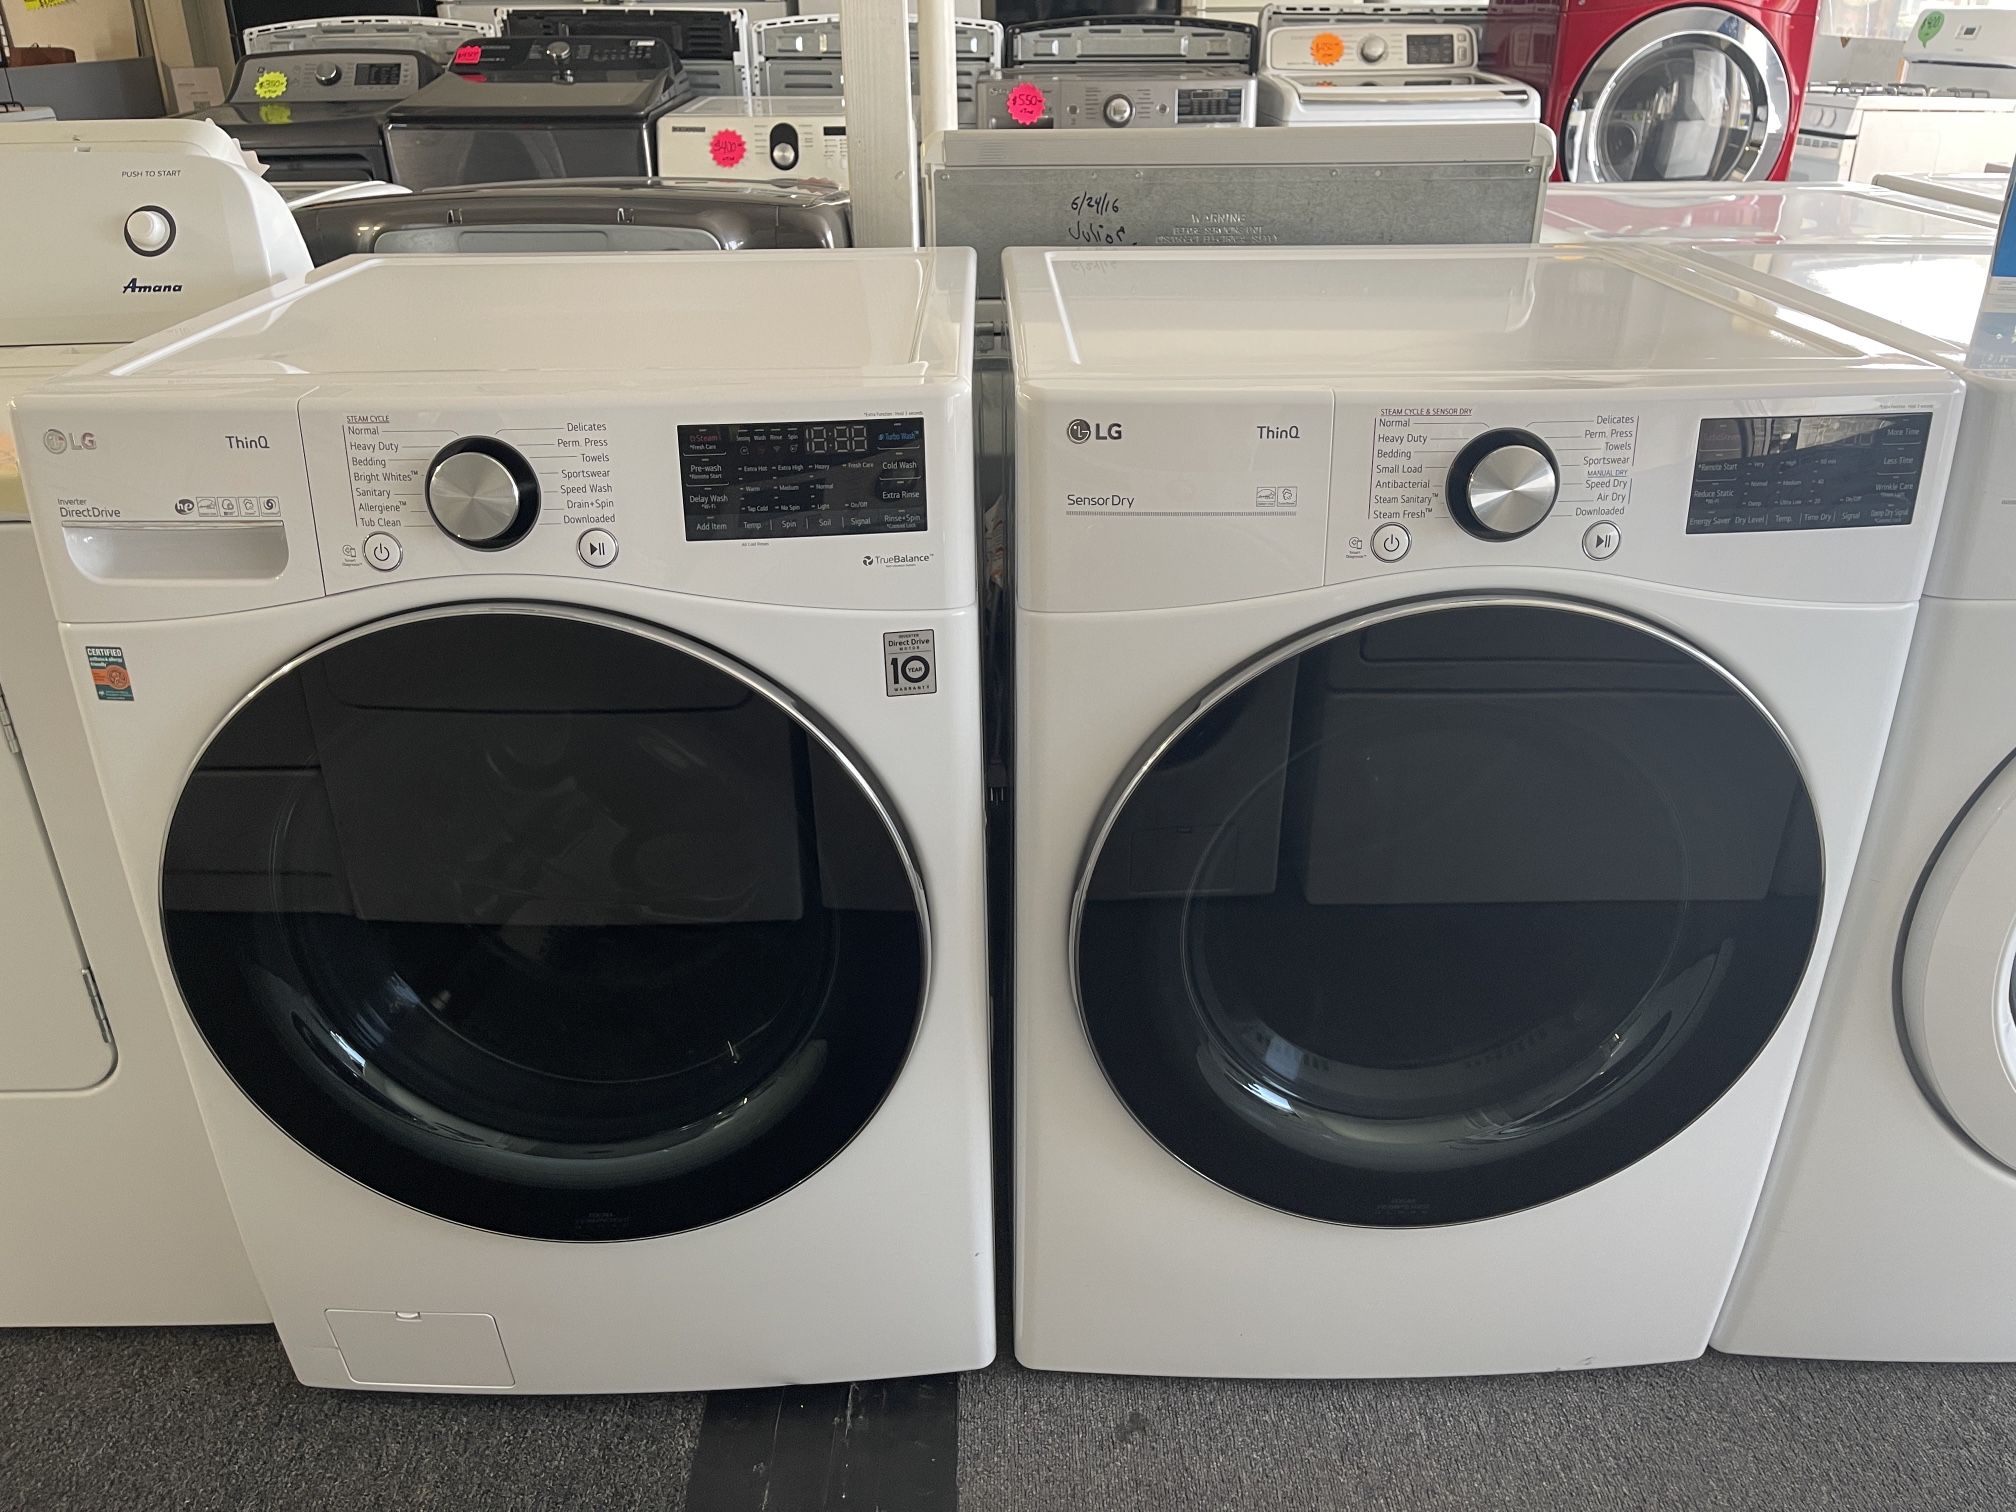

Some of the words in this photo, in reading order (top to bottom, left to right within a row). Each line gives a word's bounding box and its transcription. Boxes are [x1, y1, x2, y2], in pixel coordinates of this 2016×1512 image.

[1071, 192, 1119, 215] 6/24/16
[122, 278, 183, 294] Amana
[1380, 408, 1403, 416] STEAM
[1404, 408, 1425, 416] CYCLE
[1432, 408, 1457, 416] SENSOR
[1458, 408, 1473, 416] DRY
[1379, 418, 1411, 428] Normal
[1596, 415, 1635, 425] Delicates
[348, 426, 379, 436] Normal
[567, 422, 607, 432] Delicates
[1095, 423, 1122, 441] LG
[1256, 425, 1301, 440] ThinQ
[1584, 430, 1608, 439] Perm.
[1610, 429, 1633, 438] Press
[69, 432, 97, 450] LG
[225, 435, 270, 450] ThinQ
[557, 438, 582, 448] Perm.
[584, 438, 608, 447] Press
[1378, 434, 1405, 444] Heavy
[1407, 434, 1428, 444] Duty
[350, 442, 377, 452] Heavy
[378, 441, 399, 452] Duty
[1604, 442, 1632, 451] Towels
[580, 453, 610, 463] Towels
[1377, 449, 1411, 460] Bedding
[352, 457, 386, 468] Bedding
[883, 462, 898, 470] Cold
[900, 461, 917, 469] Wash
[1583, 455, 1630, 467] Sportswear
[690, 464, 722, 473] Pre-wash
[1376, 464, 1398, 474] Small
[1400, 464, 1423, 474] Load
[1587, 469, 1614, 477] MANUAL
[1615, 469, 1628, 477] DRY
[354, 472, 378, 484] Bright
[561, 469, 610, 479] Sportswear
[1375, 479, 1430, 489] Antibacterial
[1585, 479, 1612, 490] Speed
[1613, 479, 1628, 490] Dry
[356, 488, 391, 499] Sanitary
[560, 485, 587, 495] Speed
[589, 484, 613, 494] Wash
[690, 495, 709, 503] Delay
[710, 494, 728, 502] Wash
[882, 491, 900, 499] Extra
[1374, 495, 1399, 504] Steam
[1597, 492, 1610, 501] Air
[1611, 492, 1626, 504] Dry
[57, 498, 87, 506] Inverter
[566, 499, 614, 510] Drain+Spin
[1372, 509, 1401, 519] Steam
[1575, 506, 1625, 517] Downloaded
[1841, 512, 1861, 521] Signal
[360, 518, 376, 527] Tub
[377, 518, 402, 527] Clean
[563, 514, 616, 524] Downloaded
[851, 517, 871, 526] Signal
[1804, 513, 1819, 521] Time
[1820, 513, 1832, 522] Dry
[696, 523, 710, 531] Add
[711, 522, 727, 530] Item
[743, 522, 762, 530] Temp
[781, 520, 797, 529] Spin
[818, 519, 832, 527] Soil
[888, 639, 910, 647] Direct
[911, 638, 930, 646] Drive
[87, 648, 122, 657] CERTIFIED
[890, 655, 930, 685] 10
